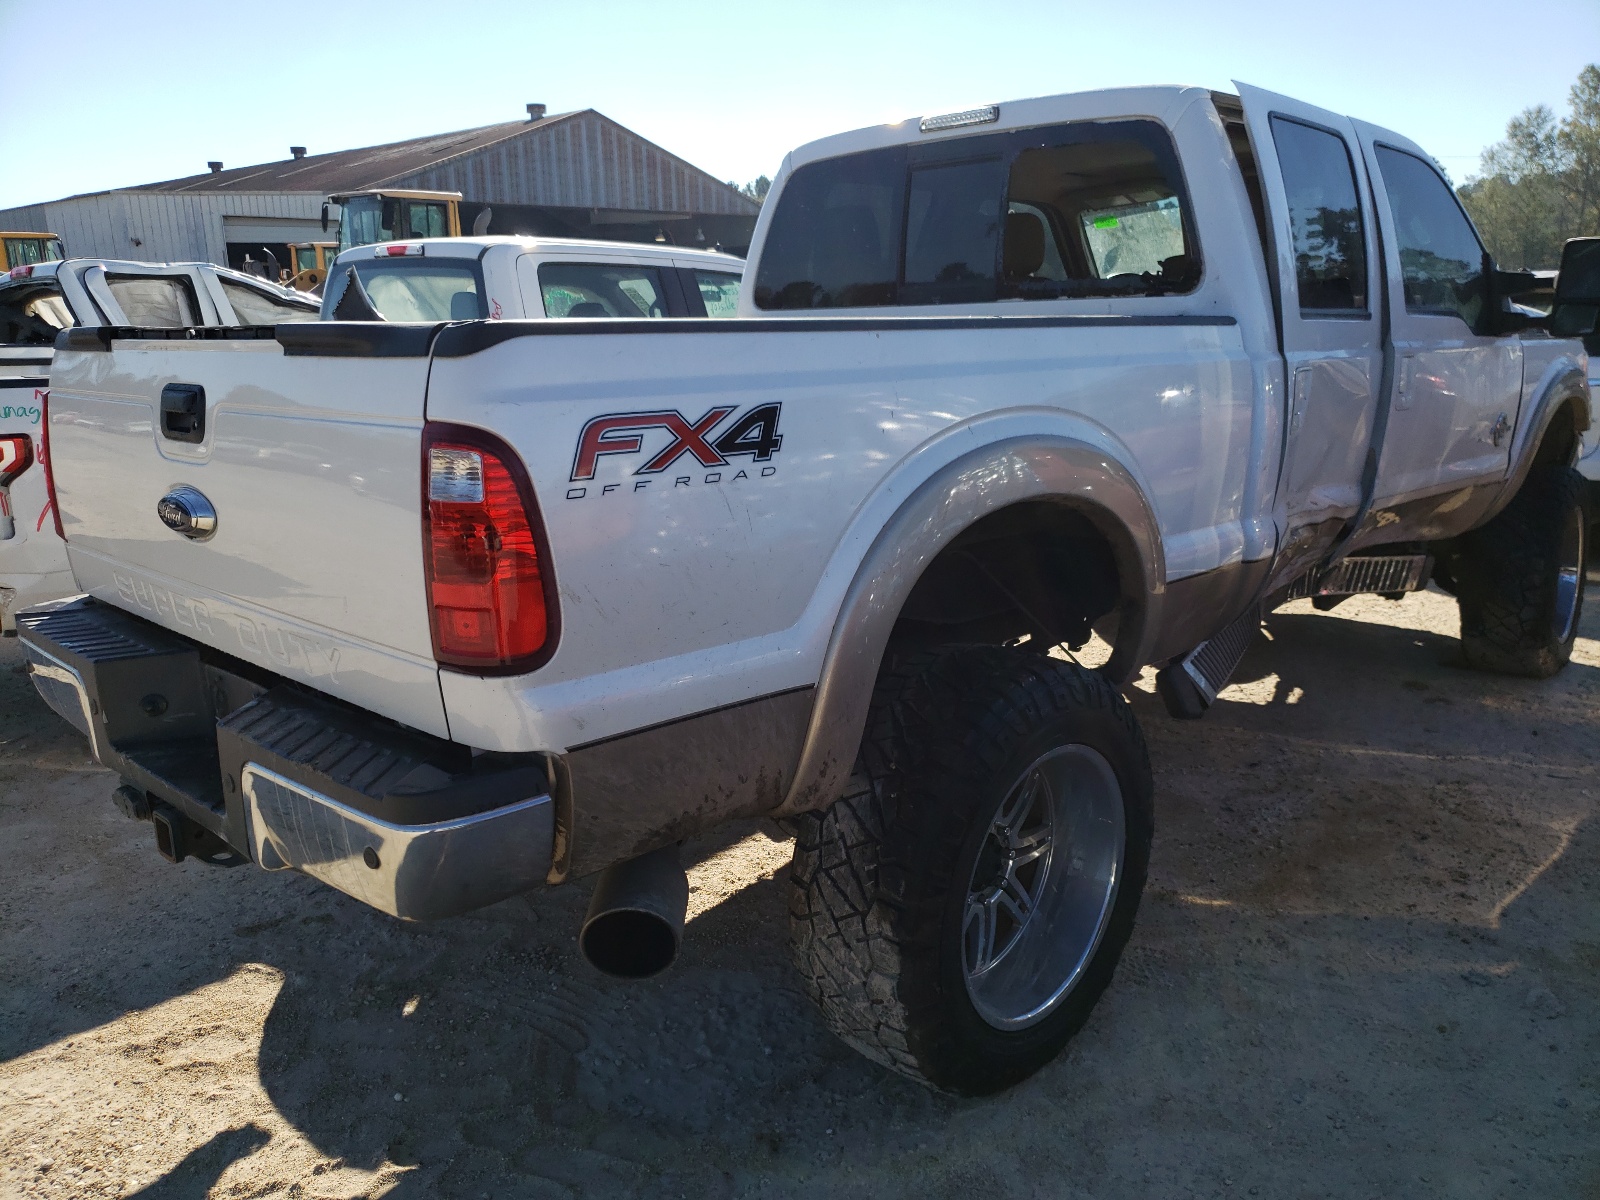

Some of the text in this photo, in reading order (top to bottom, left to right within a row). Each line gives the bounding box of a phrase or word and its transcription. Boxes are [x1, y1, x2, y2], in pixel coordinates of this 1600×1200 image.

[0, 405, 41, 425] mag
[568, 401, 784, 483] FX4
[112, 569, 342, 685] SUPER DUTY
